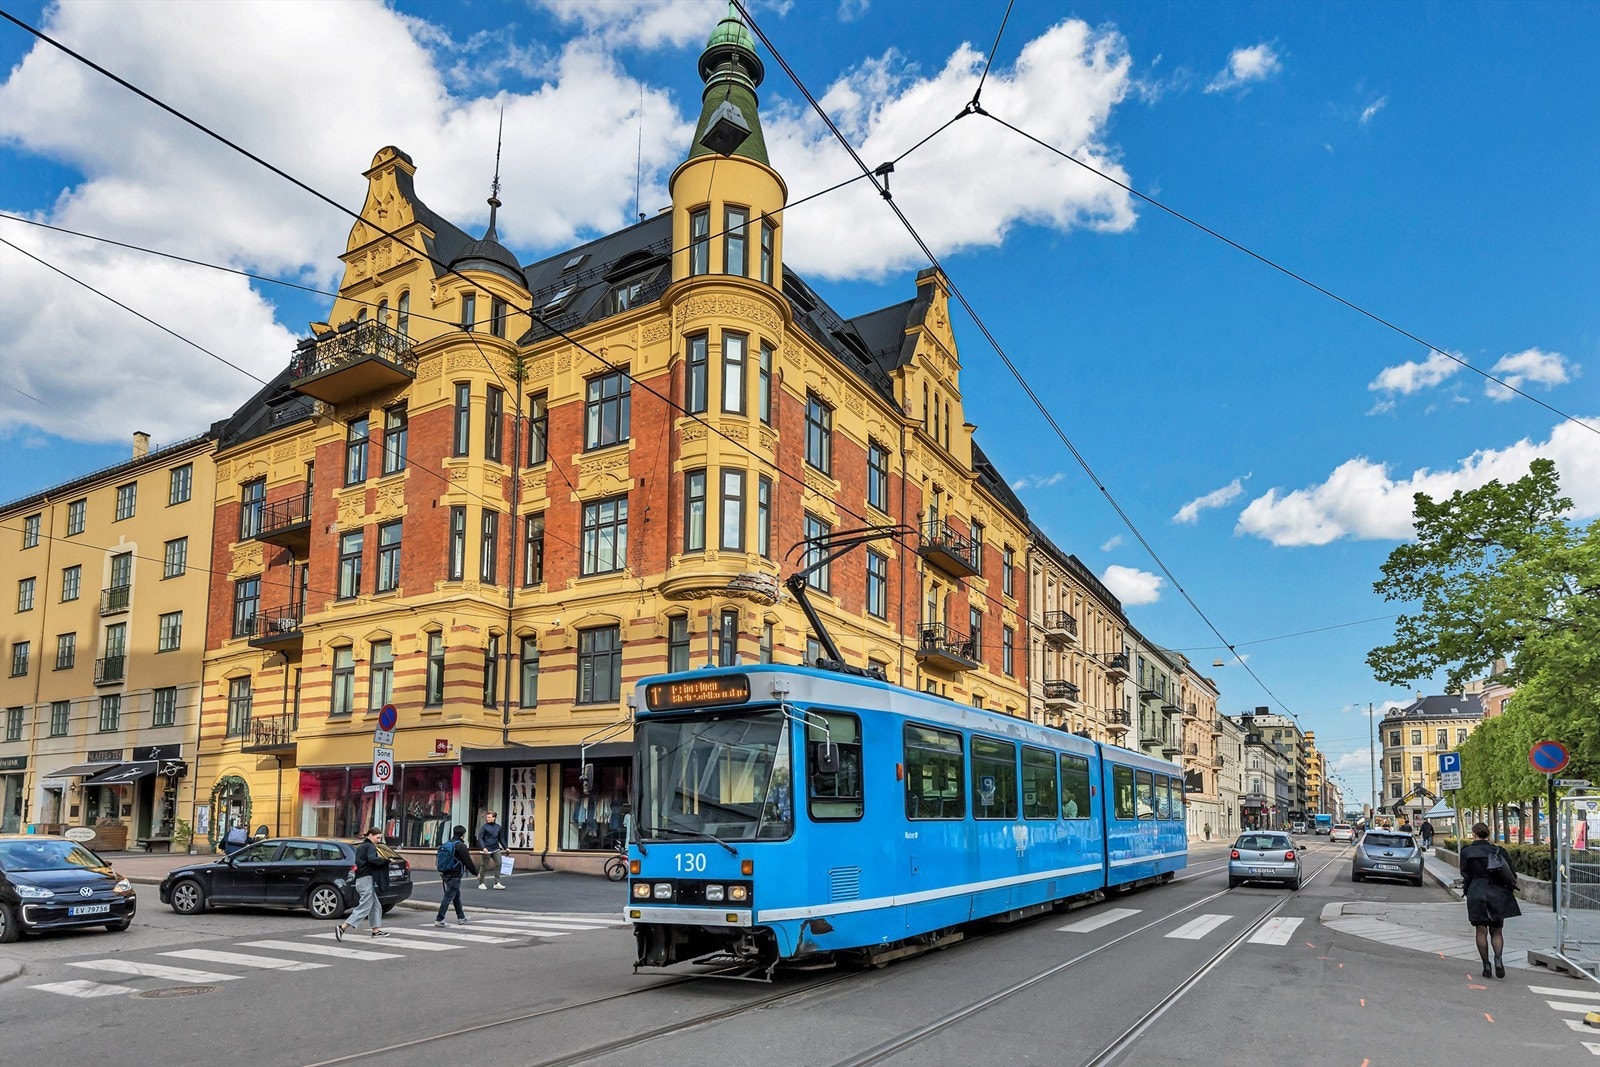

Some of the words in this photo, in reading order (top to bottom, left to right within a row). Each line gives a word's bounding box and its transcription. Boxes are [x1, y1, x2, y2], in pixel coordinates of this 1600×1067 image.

[376, 750, 391, 758] Sone
[1444, 755, 1455, 770] P
[378, 765, 389, 776] 30
[674, 853, 707, 872] 130
[87, 905, 108, 913] 79756
